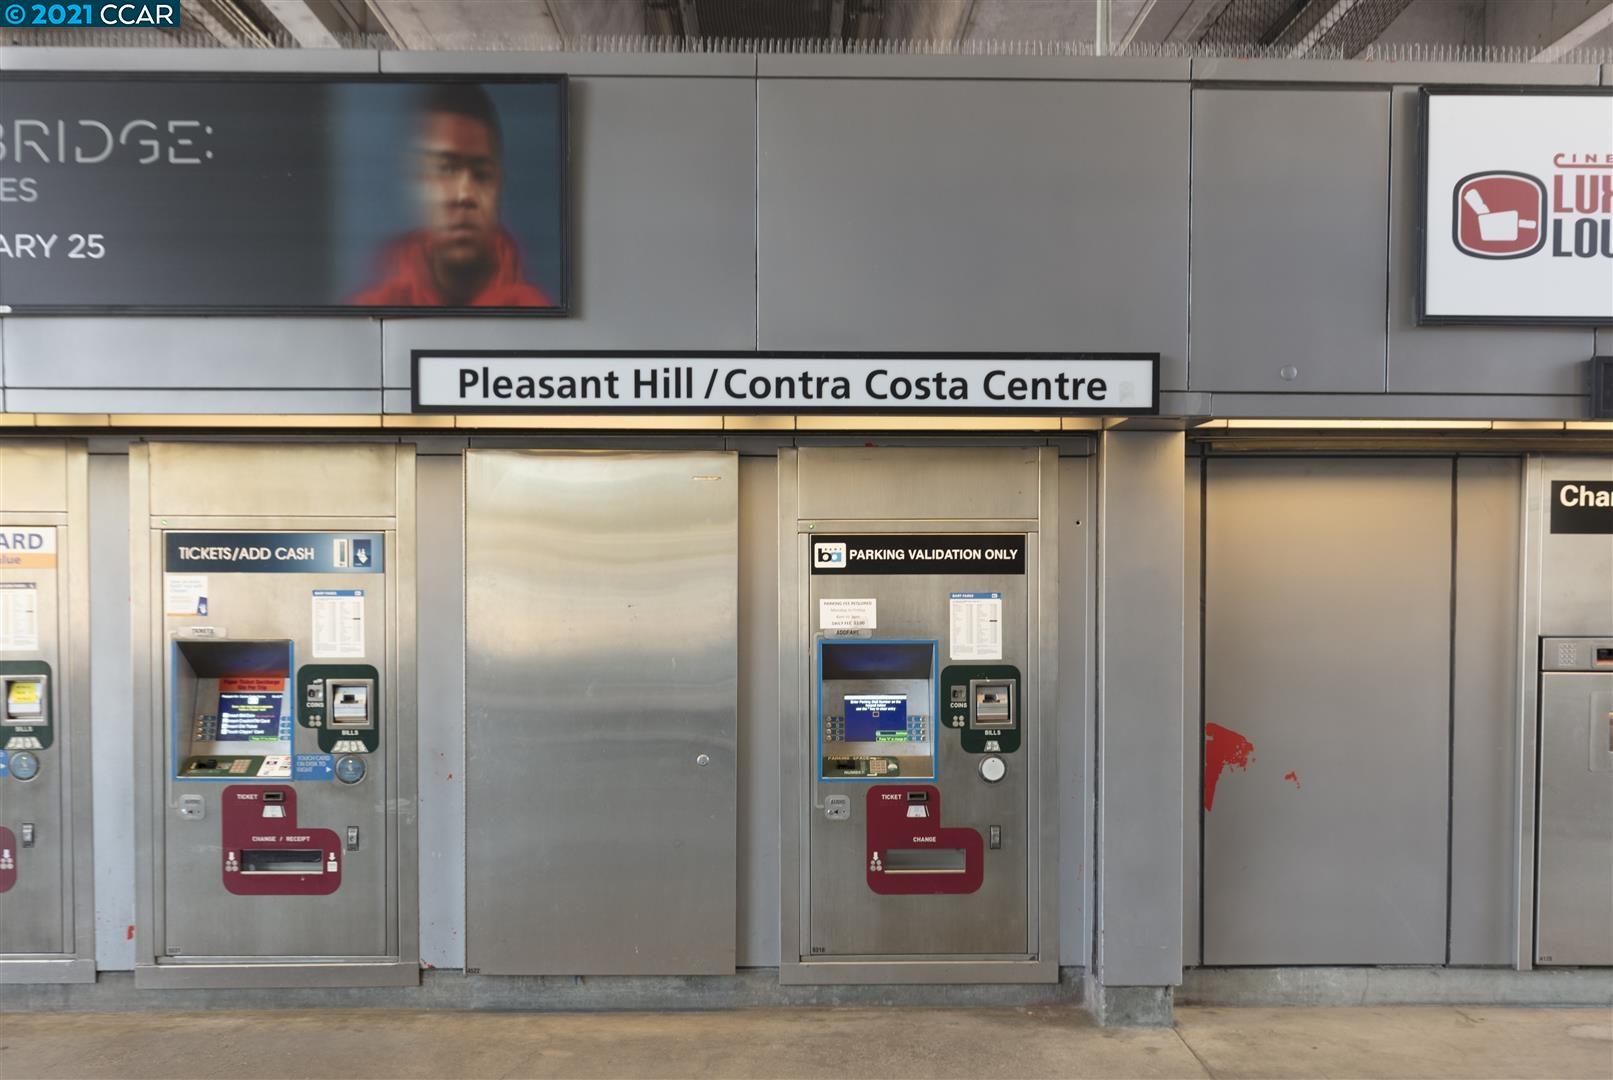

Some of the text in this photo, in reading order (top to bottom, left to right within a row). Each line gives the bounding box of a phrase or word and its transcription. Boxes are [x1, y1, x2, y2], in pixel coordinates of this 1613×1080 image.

[0, 119, 214, 164] RIDGE:
[67, 233, 105, 259] 25
[458, 366, 620, 400] Pleasant
[633, 366, 693, 400] Hill
[865, 368, 969, 402] Costa
[983, 369, 1108, 402] Centre
[1560, 484, 1613, 507] Cha
[178, 546, 315, 562] TICKETS/ADD CASH
[849, 548, 1018, 561] PARKING VALIDATION ONLY
